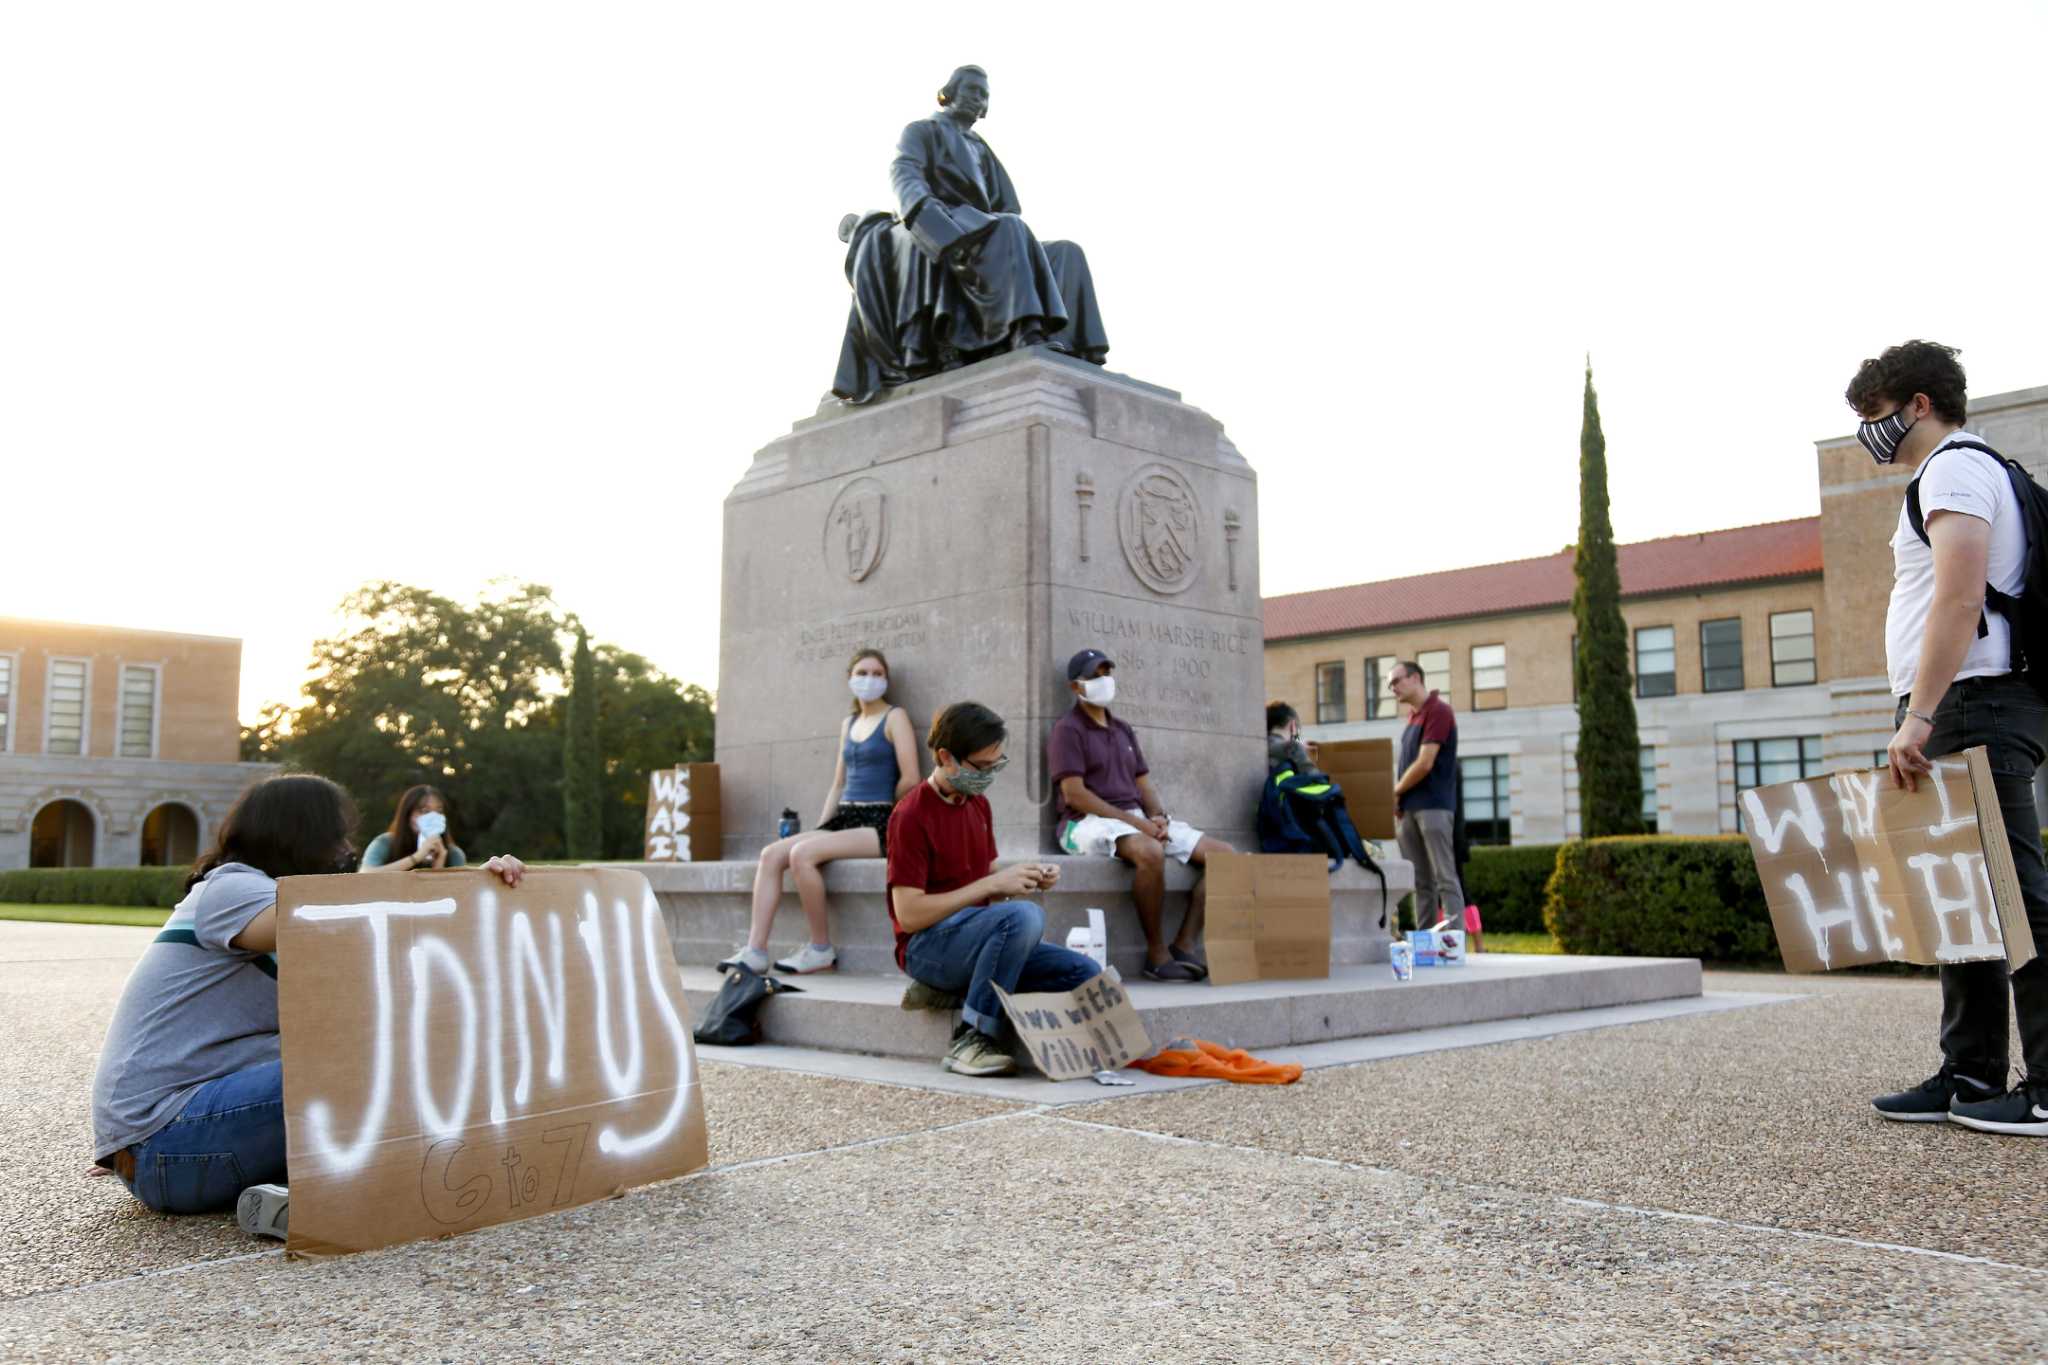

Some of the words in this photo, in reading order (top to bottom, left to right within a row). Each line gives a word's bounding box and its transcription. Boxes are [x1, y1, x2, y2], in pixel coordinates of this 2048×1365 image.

[1068, 608, 1141, 638] WILLIAM
[1149, 622, 1205, 650] MARSH
[1212, 631, 1250, 656] RICE
[1173, 656, 1211, 679] 1900
[1785, 866, 1903, 963] HE
[293, 888, 567, 1174] JOIN
[577, 884, 691, 1155] US
[1065, 978, 1123, 1026] with
[502, 1145, 540, 1209] to
[542, 1121, 592, 1208] 7
